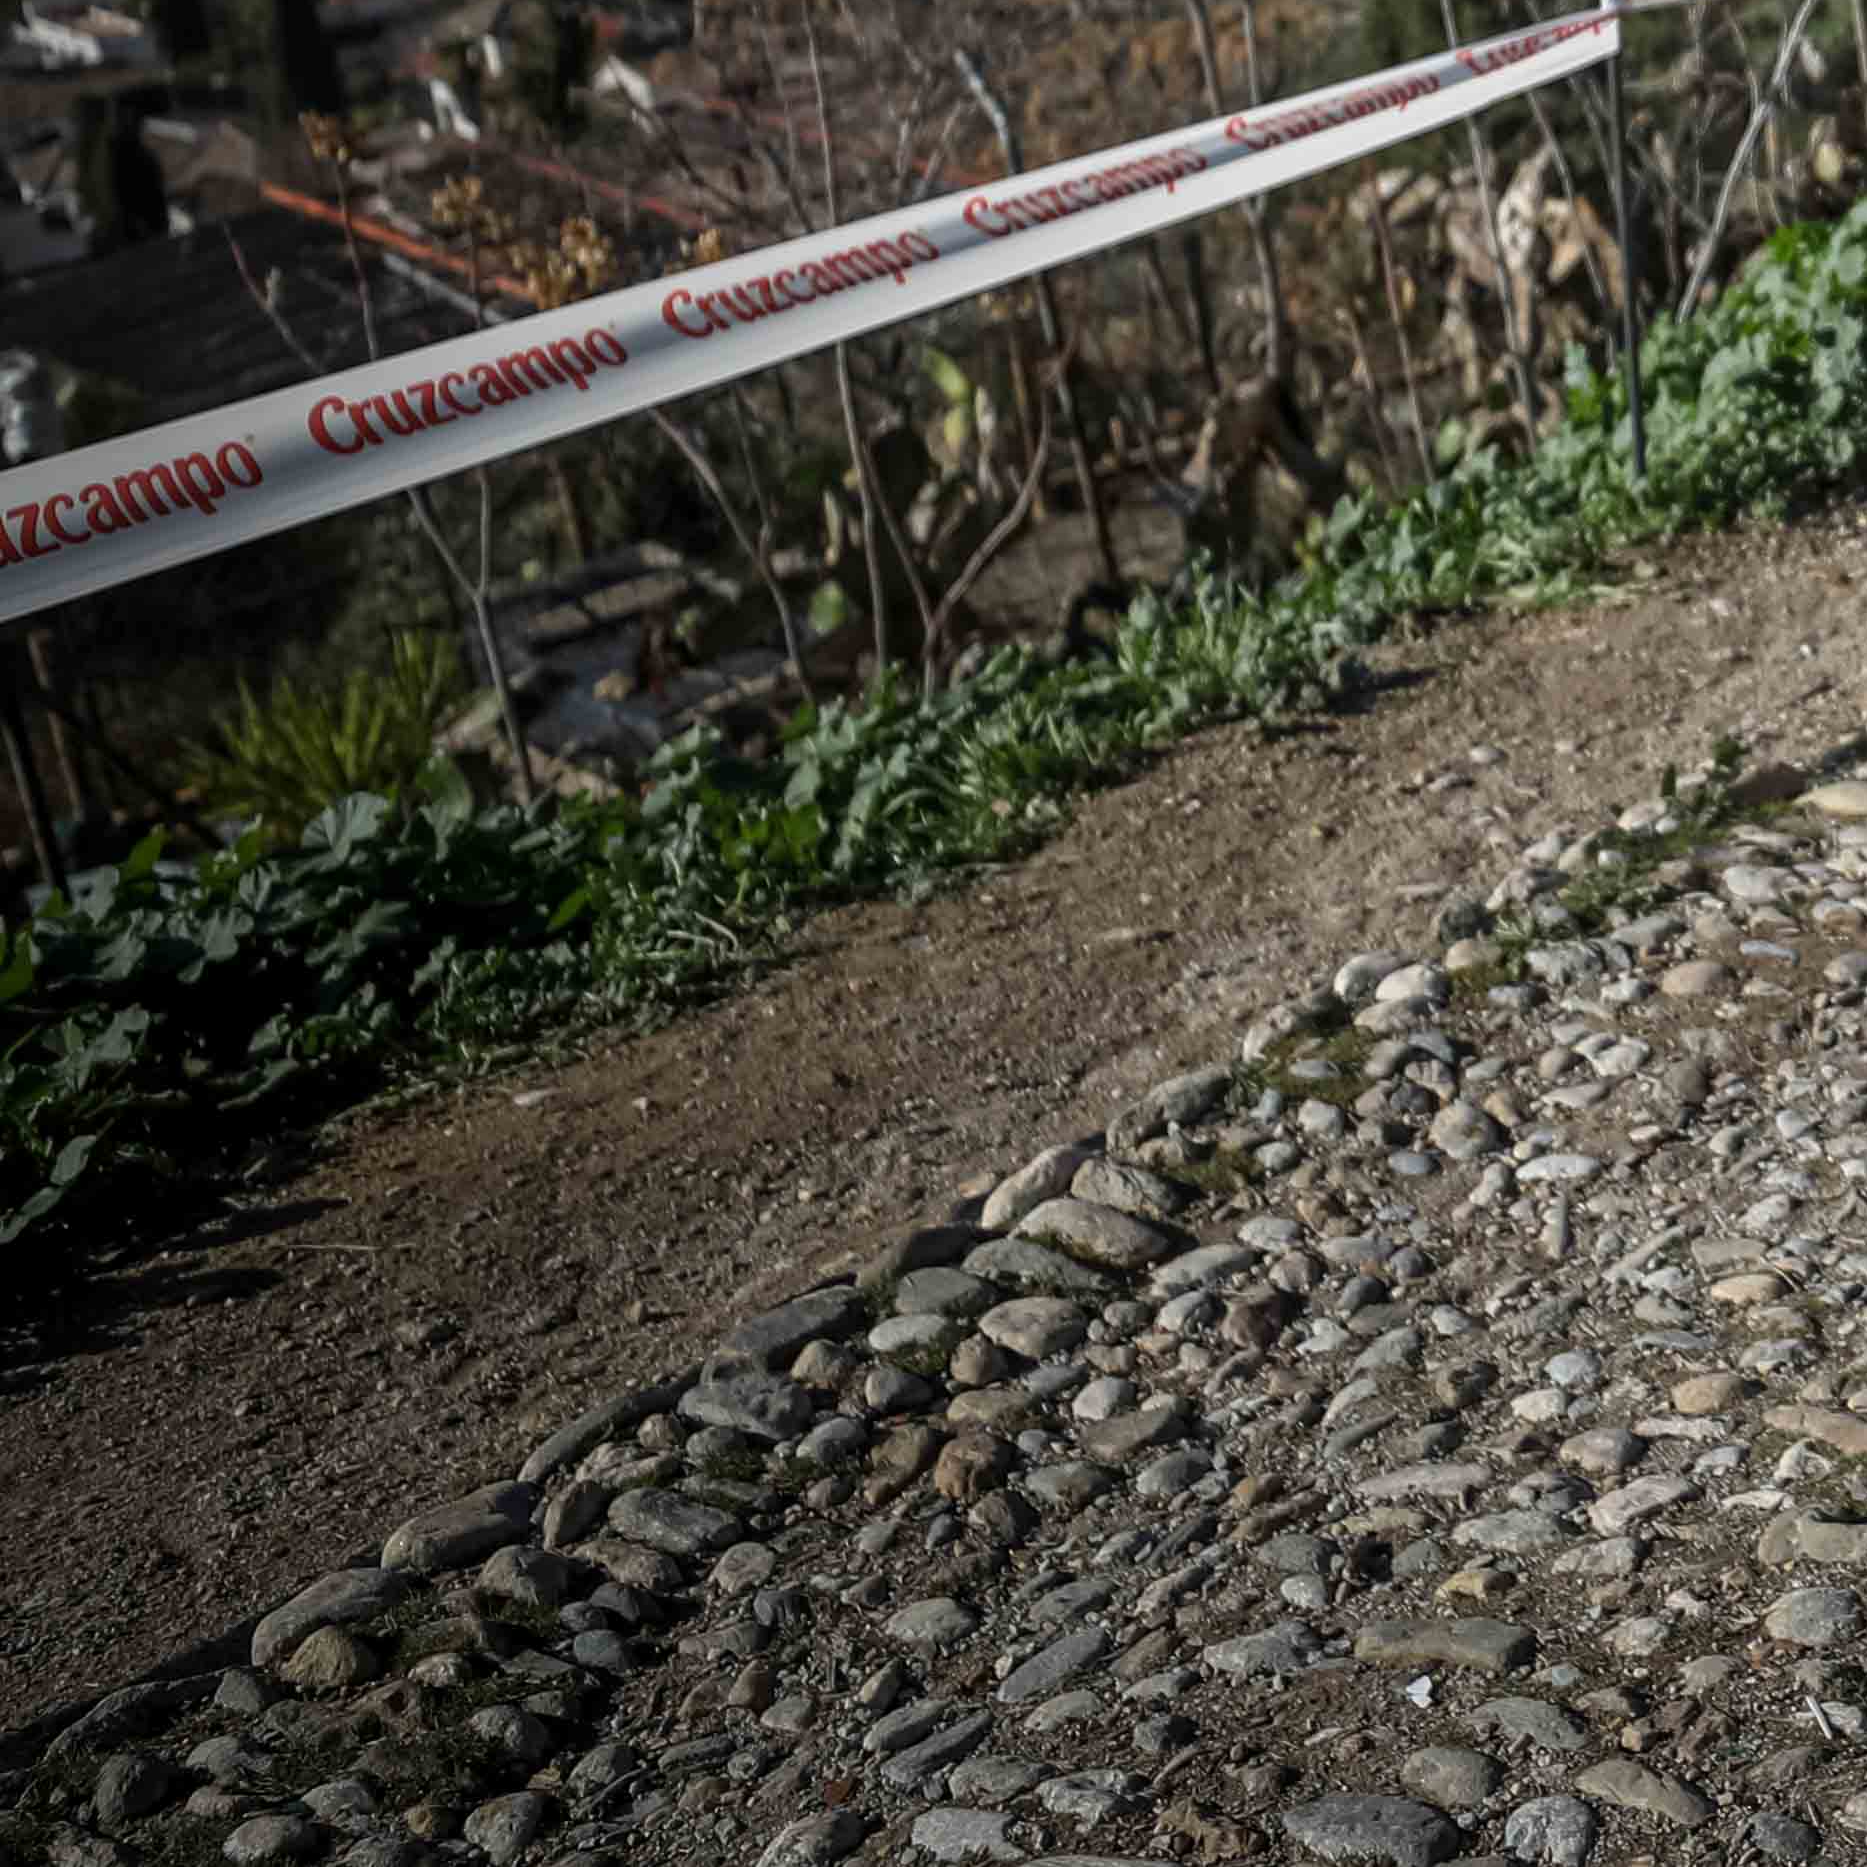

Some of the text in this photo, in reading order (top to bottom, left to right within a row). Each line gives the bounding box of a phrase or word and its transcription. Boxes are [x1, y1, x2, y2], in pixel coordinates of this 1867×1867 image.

[963, 145, 1208, 238] Cruzcampo
[661, 230, 941, 339] Cruzcampo
[307, 327, 628, 455] Cruzcampo
